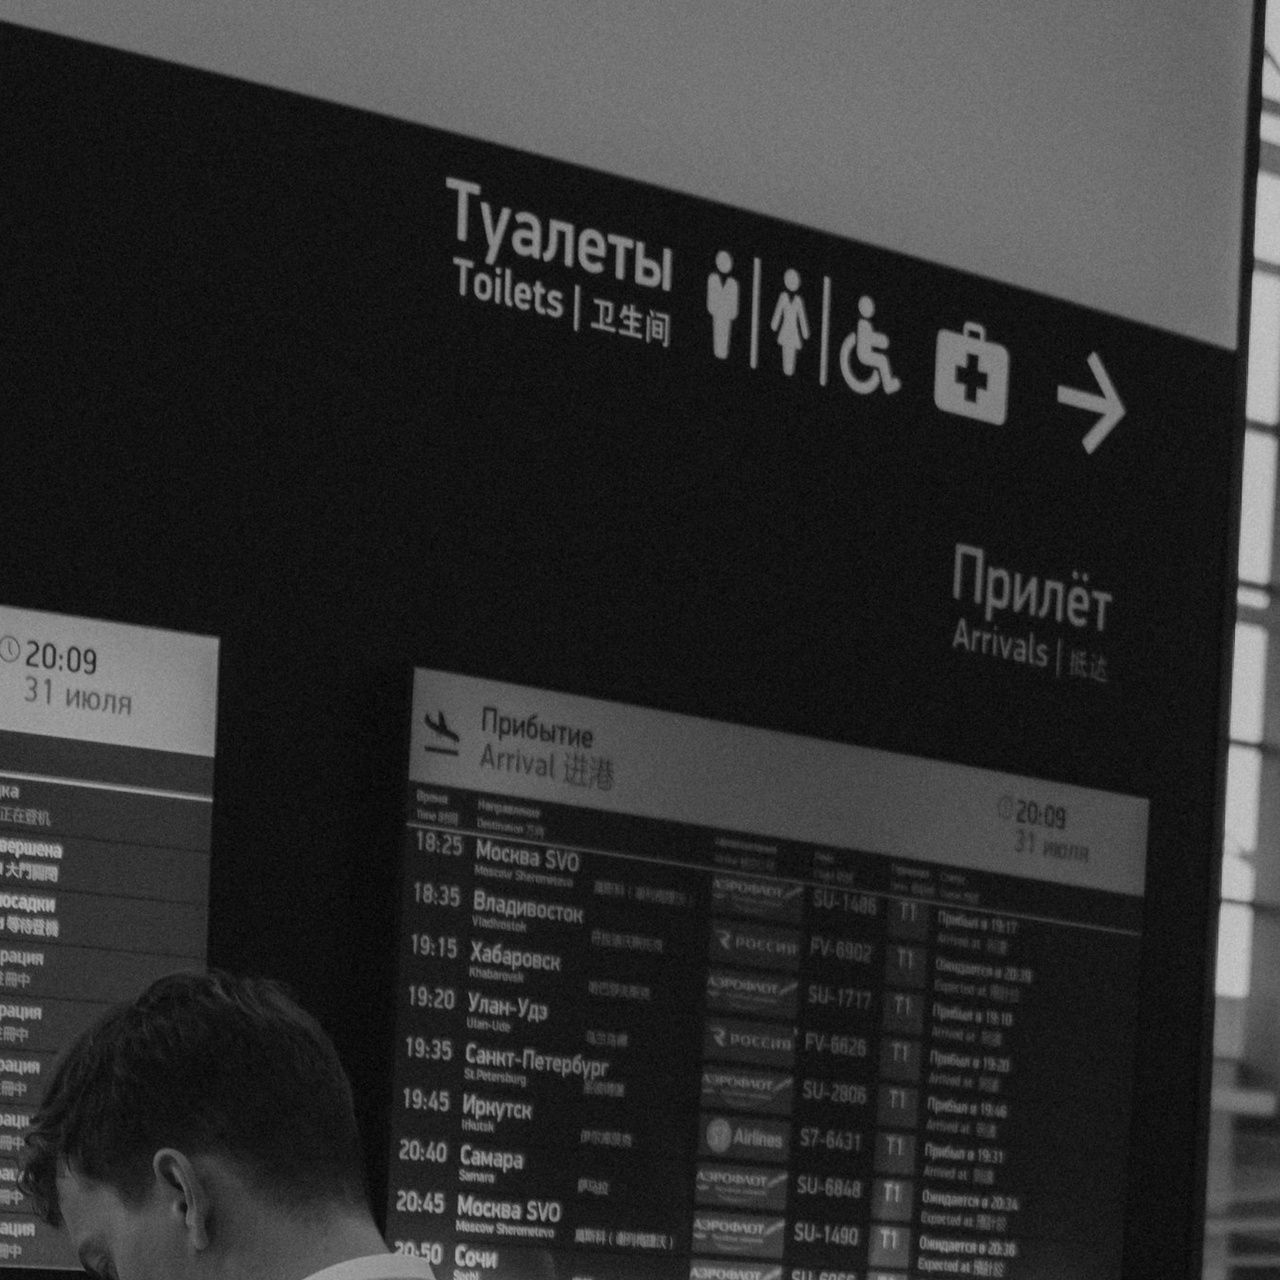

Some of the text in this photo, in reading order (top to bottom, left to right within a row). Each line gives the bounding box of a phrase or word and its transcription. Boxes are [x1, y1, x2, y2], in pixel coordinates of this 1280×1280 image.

[446, 177, 673, 291] Туалеты
[452, 256, 671, 348] Toilets 卫生间
[953, 543, 1113, 632] Прилёт
[25, 640, 97, 675] 20:09
[952, 618, 1048, 668] Arrivals
[24, 676, 132, 716] 31 июля
[482, 706, 593, 749] Прибытие
[480, 743, 556, 780] Arrival
[1017, 800, 1066, 830] 20:09
[417, 831, 462, 856] 18:25
[476, 838, 580, 872] Москва SVO
[414, 881, 460, 907] 18:35
[473, 889, 584, 924] Владивосток
[411, 933, 457, 959] 19:15
[471, 940, 561, 972] Хабаровск
[409, 985, 455, 1010] 19:20
[468, 991, 548, 1023] Улан-Удэ
[406, 1036, 452, 1061] 19:35
[465, 1043, 610, 1080] Санкт-Петербург
[403, 1087, 450, 1112] 19:45
[463, 1092, 533, 1122] Иркутск
[398, 1138, 447, 1163] 20:40
[460, 1144, 524, 1174] Самара
[396, 1190, 445, 1214] 20:45
[457, 1194, 562, 1223] Москва SVO
[793, 1222, 859, 1246] SU-1490
[454, 1243, 499, 1269] Сочи
